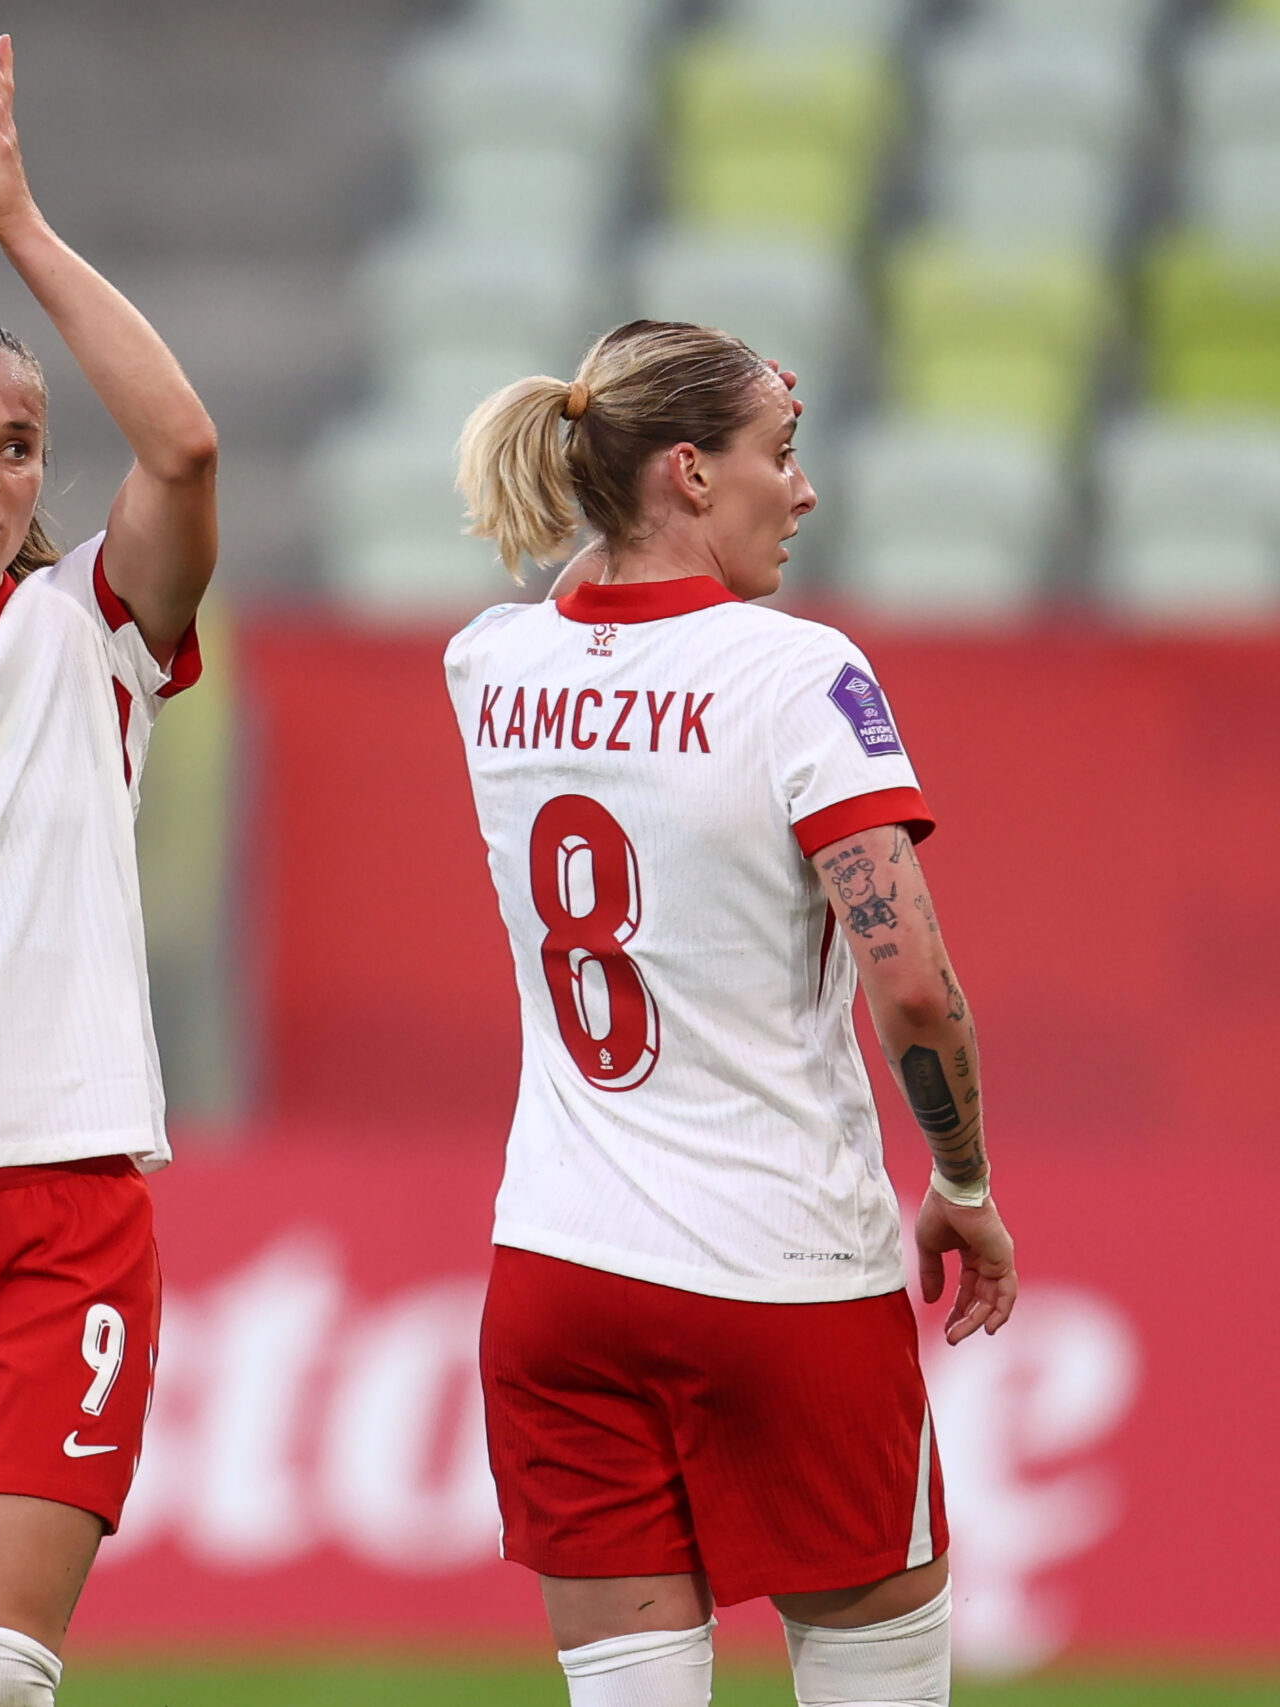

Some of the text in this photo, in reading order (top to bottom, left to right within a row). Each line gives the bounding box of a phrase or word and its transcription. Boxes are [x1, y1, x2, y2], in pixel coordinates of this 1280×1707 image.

[477, 684, 715, 754] KAMCZYK
[530, 794, 660, 1092] 8
[80, 1303, 125, 1417] 9
